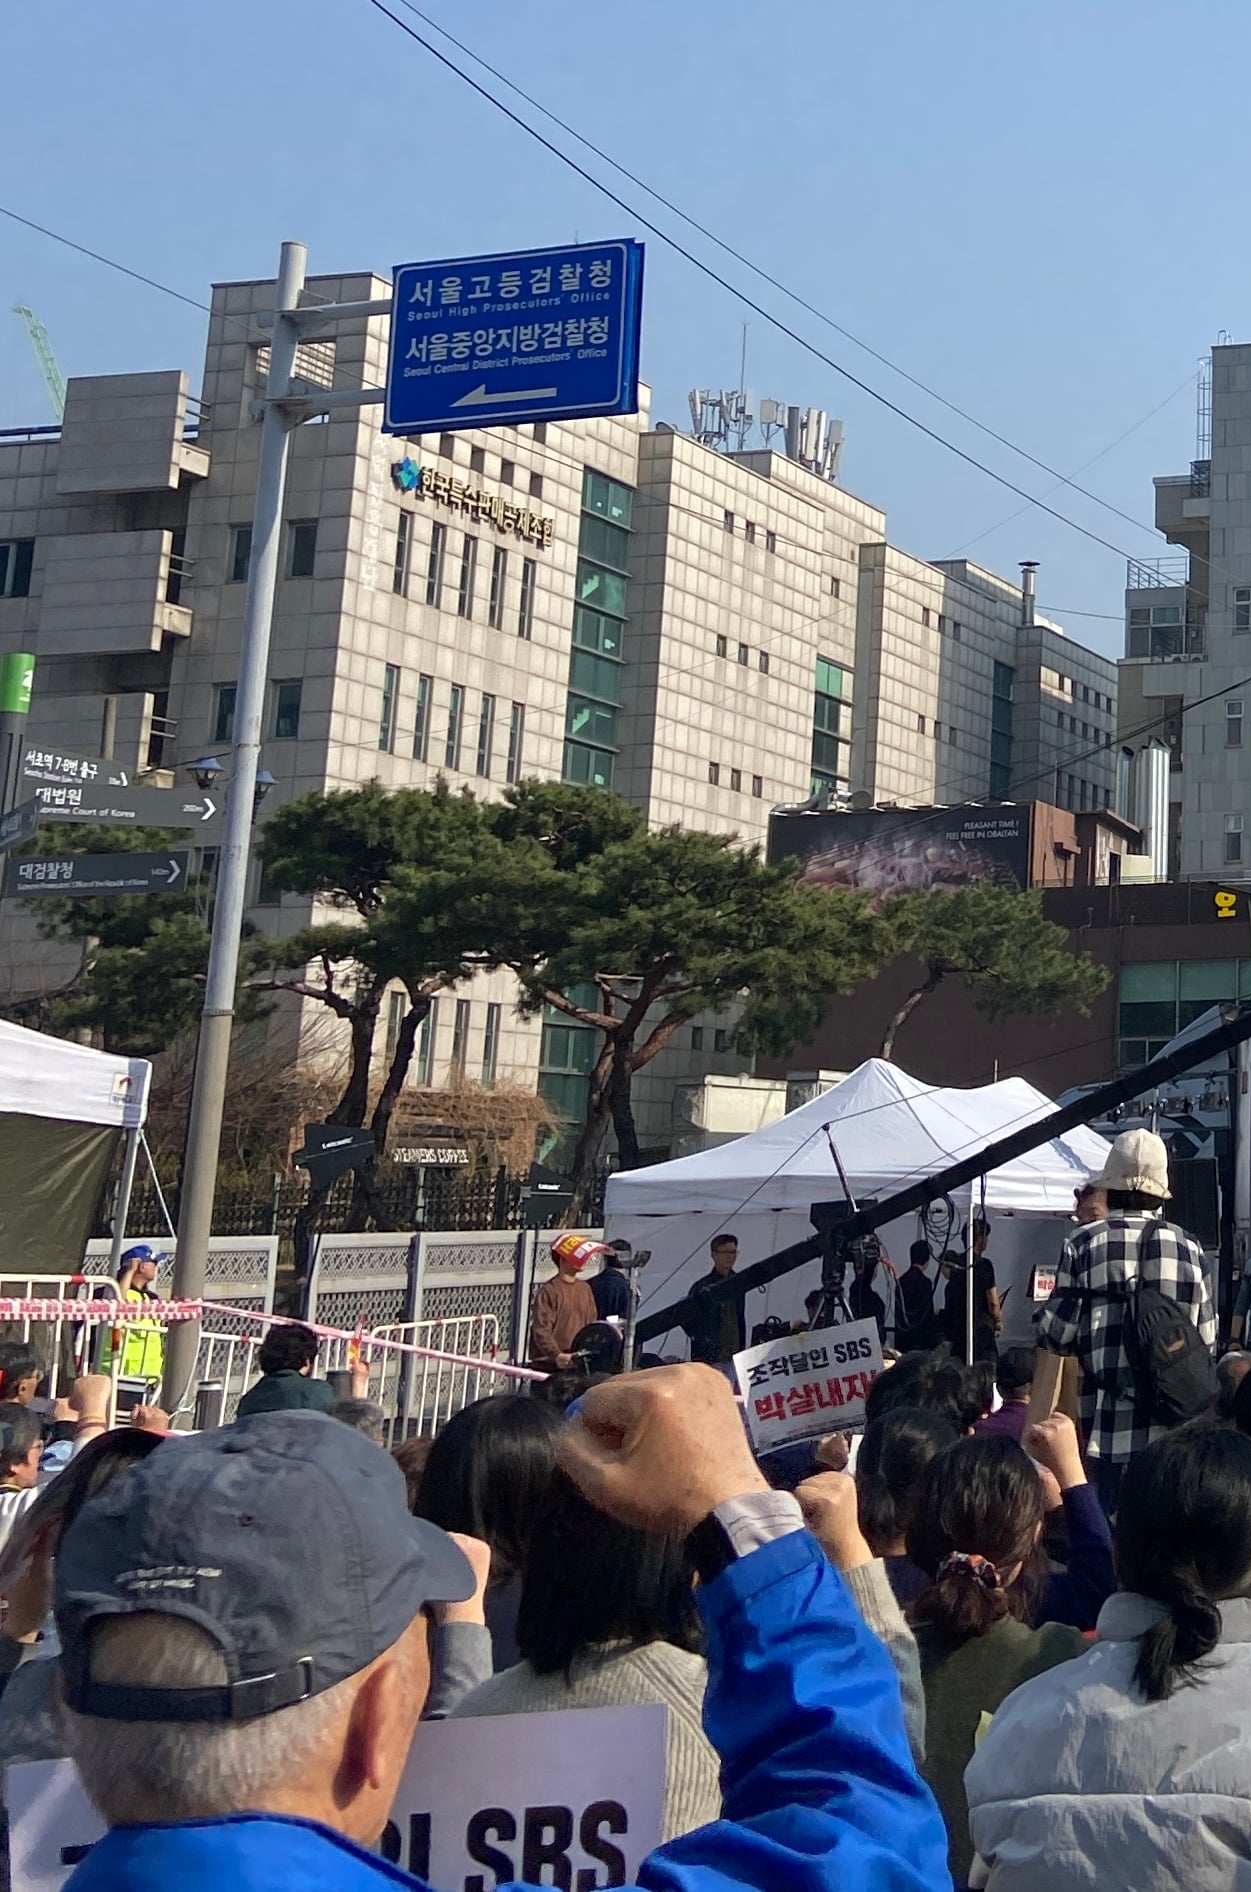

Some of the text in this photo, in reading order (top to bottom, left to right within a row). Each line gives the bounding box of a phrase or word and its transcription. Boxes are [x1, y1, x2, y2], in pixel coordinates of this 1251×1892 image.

[408, 259, 613, 306] 서울고등검찰청
[407, 311, 443, 323] Seoul
[448, 305, 477, 318] High
[571, 292, 610, 304] Office
[405, 315, 610, 363] 서울중앙지방검찰청
[403, 365, 432, 378] Seoul
[434, 362, 469, 375] Central
[472, 357, 509, 371] District
[577, 348, 608, 361] Office
[35, 787, 83, 806] 대법원
[72, 807, 97, 816] Court
[99, 808, 109, 817] of
[111, 809, 136, 818] Korea
[19, 861, 74, 880] 대검찰청
[746, 1337, 873, 1388] 조작달인 SBS
[754, 1369, 877, 1423] 박살내자
